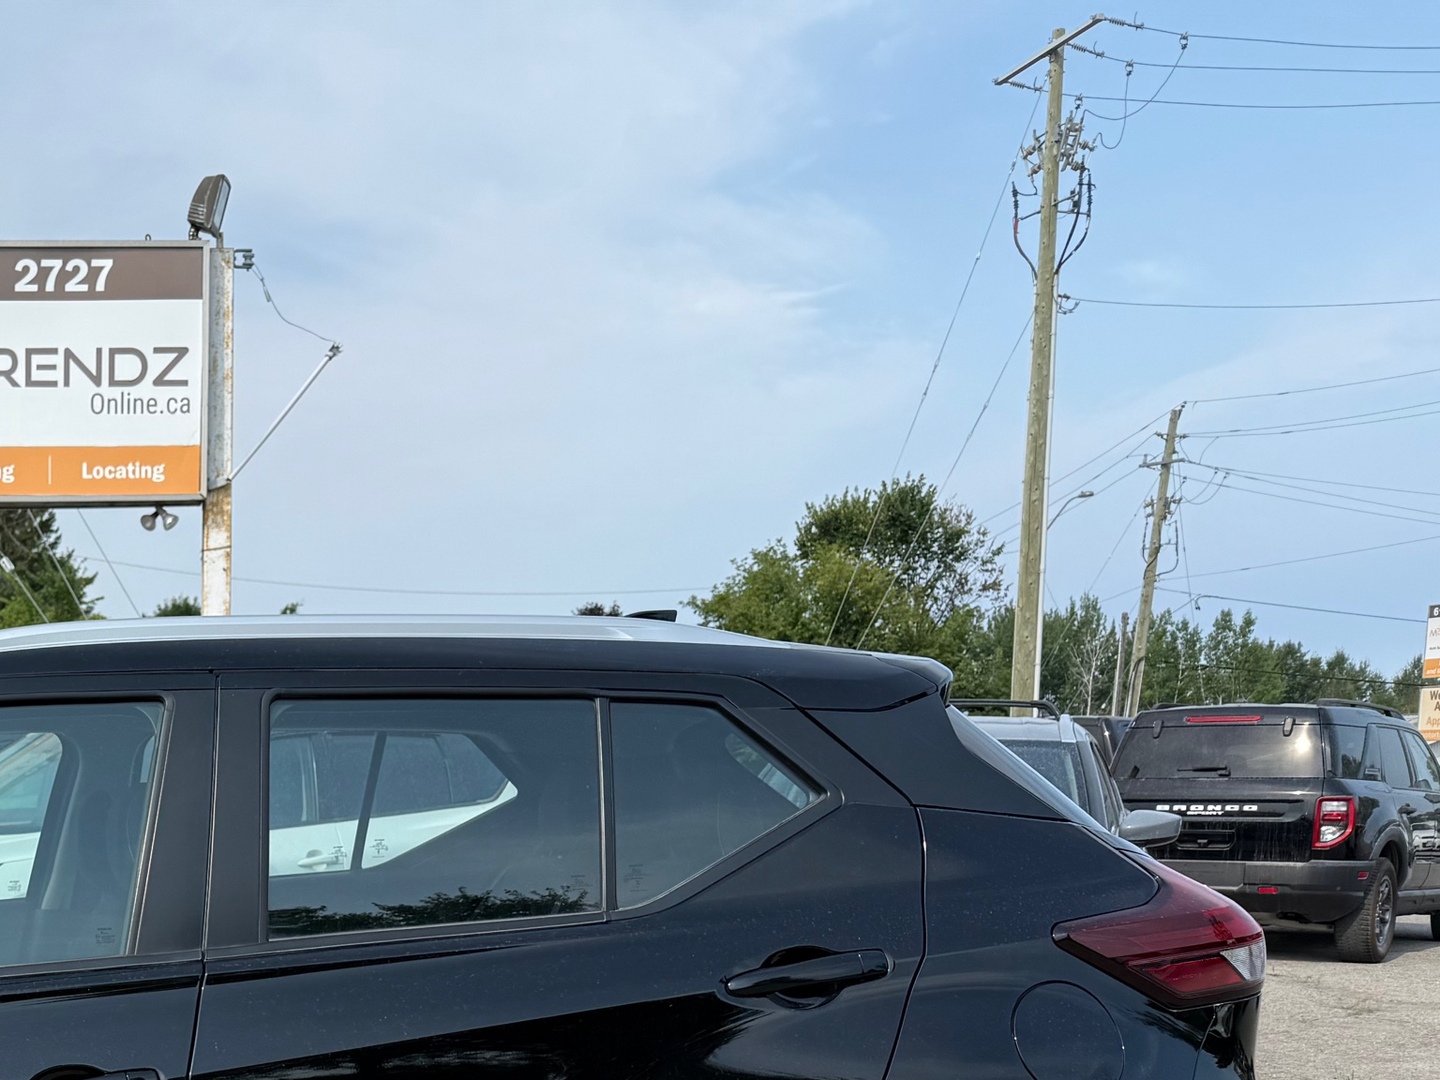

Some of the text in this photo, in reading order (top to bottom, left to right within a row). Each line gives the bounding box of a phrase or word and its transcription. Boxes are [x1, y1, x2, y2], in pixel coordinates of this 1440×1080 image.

[14, 258, 114, 293] 2727
[90, 391, 192, 416] Online.ca
[81, 461, 166, 483] Locating
